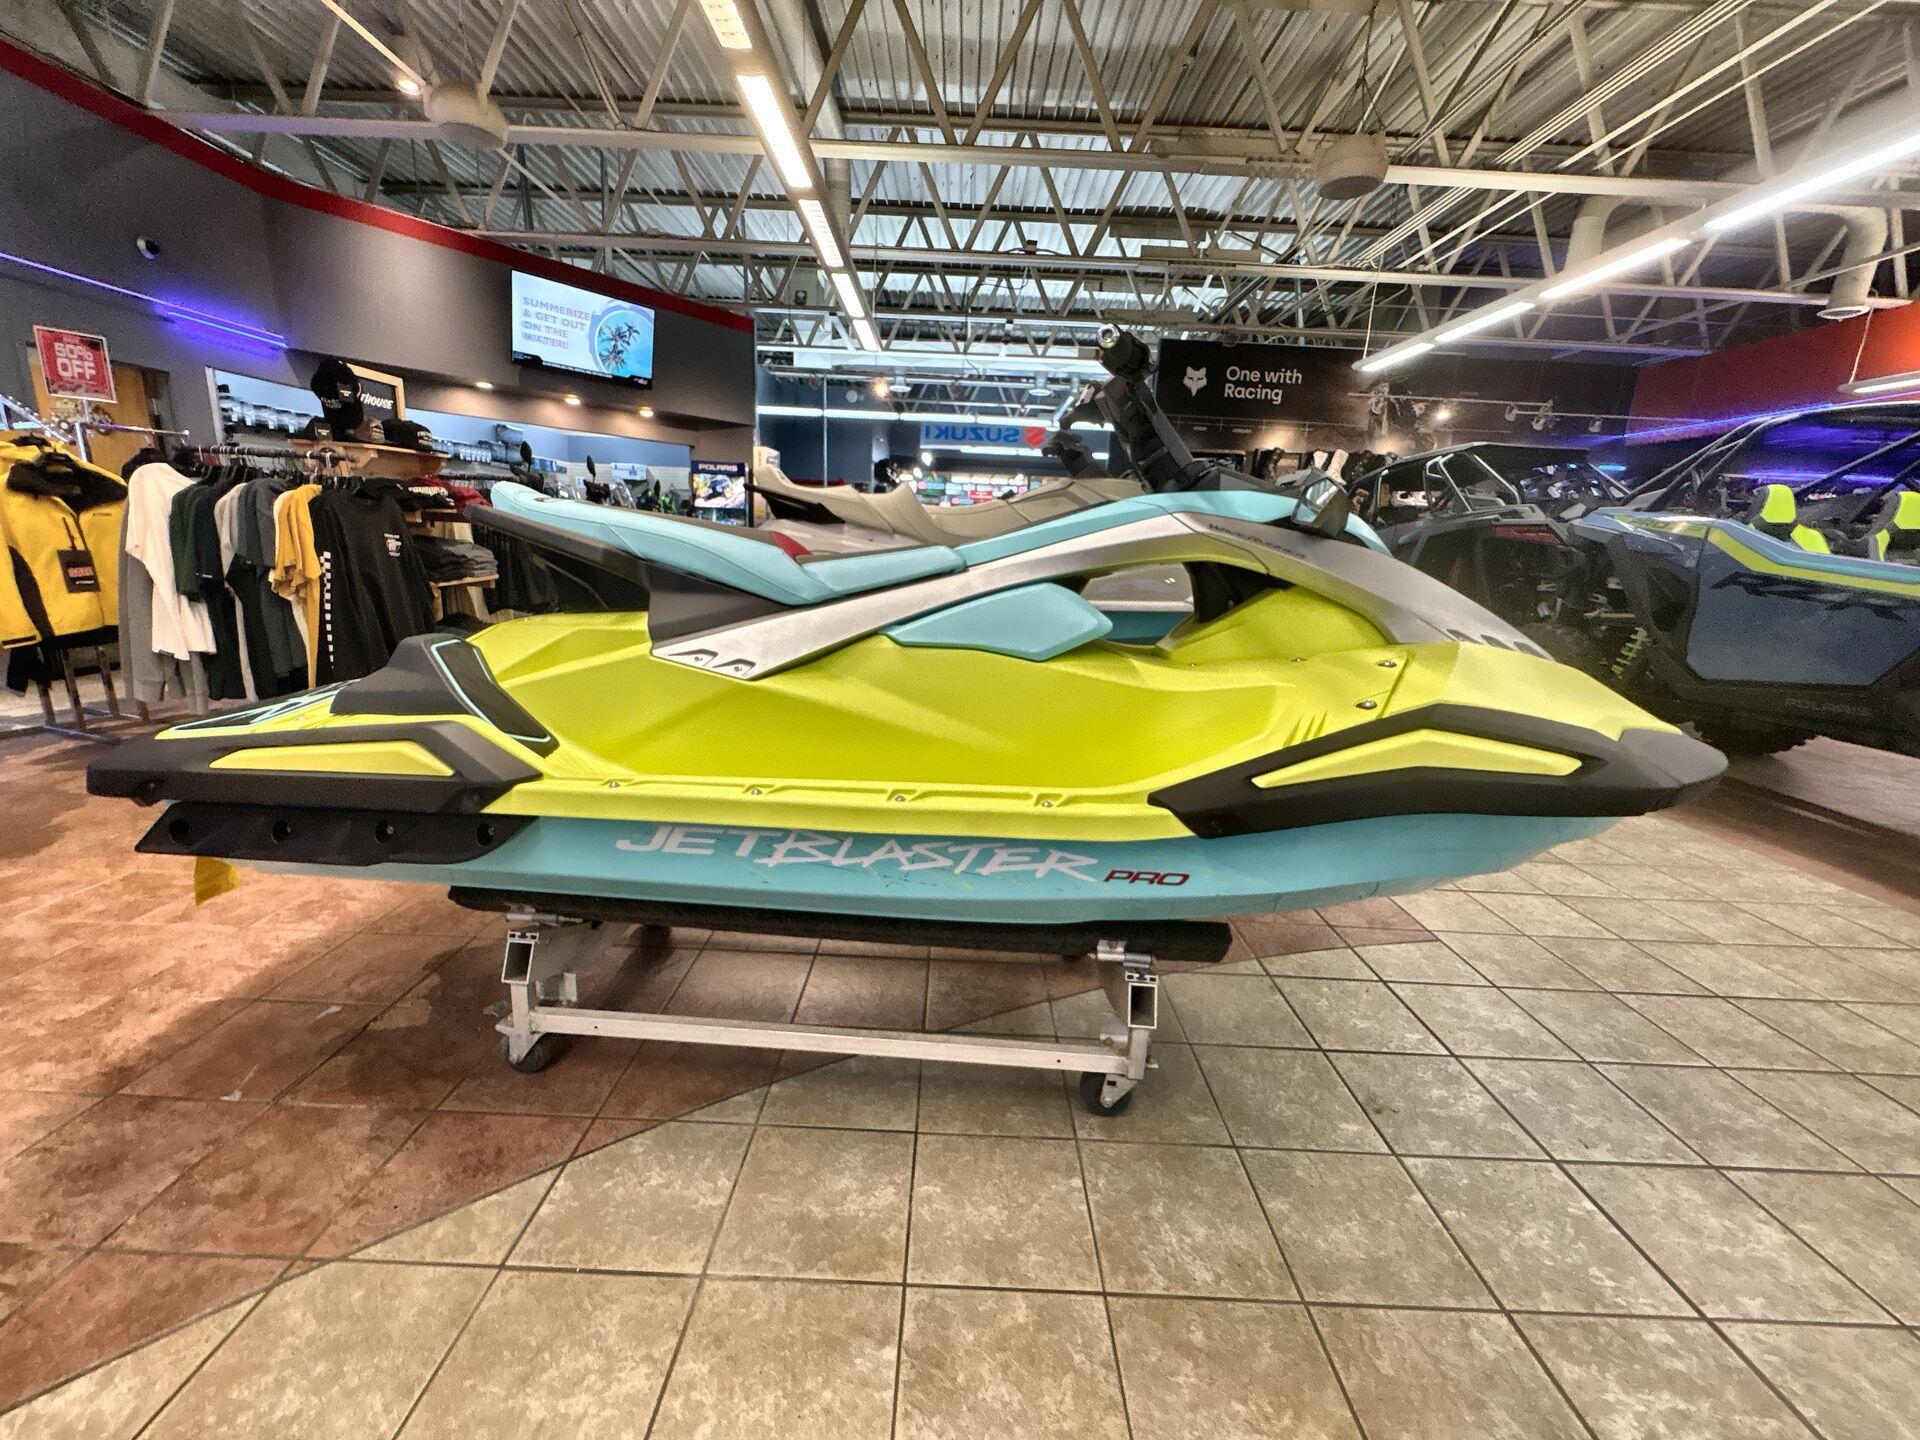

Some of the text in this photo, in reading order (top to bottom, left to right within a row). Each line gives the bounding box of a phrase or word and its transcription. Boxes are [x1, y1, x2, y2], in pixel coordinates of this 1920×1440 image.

[522, 296, 590, 321] SUMMERIZE
[521, 321, 569, 338] ON THE
[522, 308, 587, 331] & GET OUT
[53, 341, 93, 361] 50%
[56, 357, 97, 379] OFF
[1226, 365, 1303, 385] One with
[1223, 383, 1283, 405] Racing
[698, 463, 738, 471] POLARIS
[1103, 869, 1190, 887] PRO
